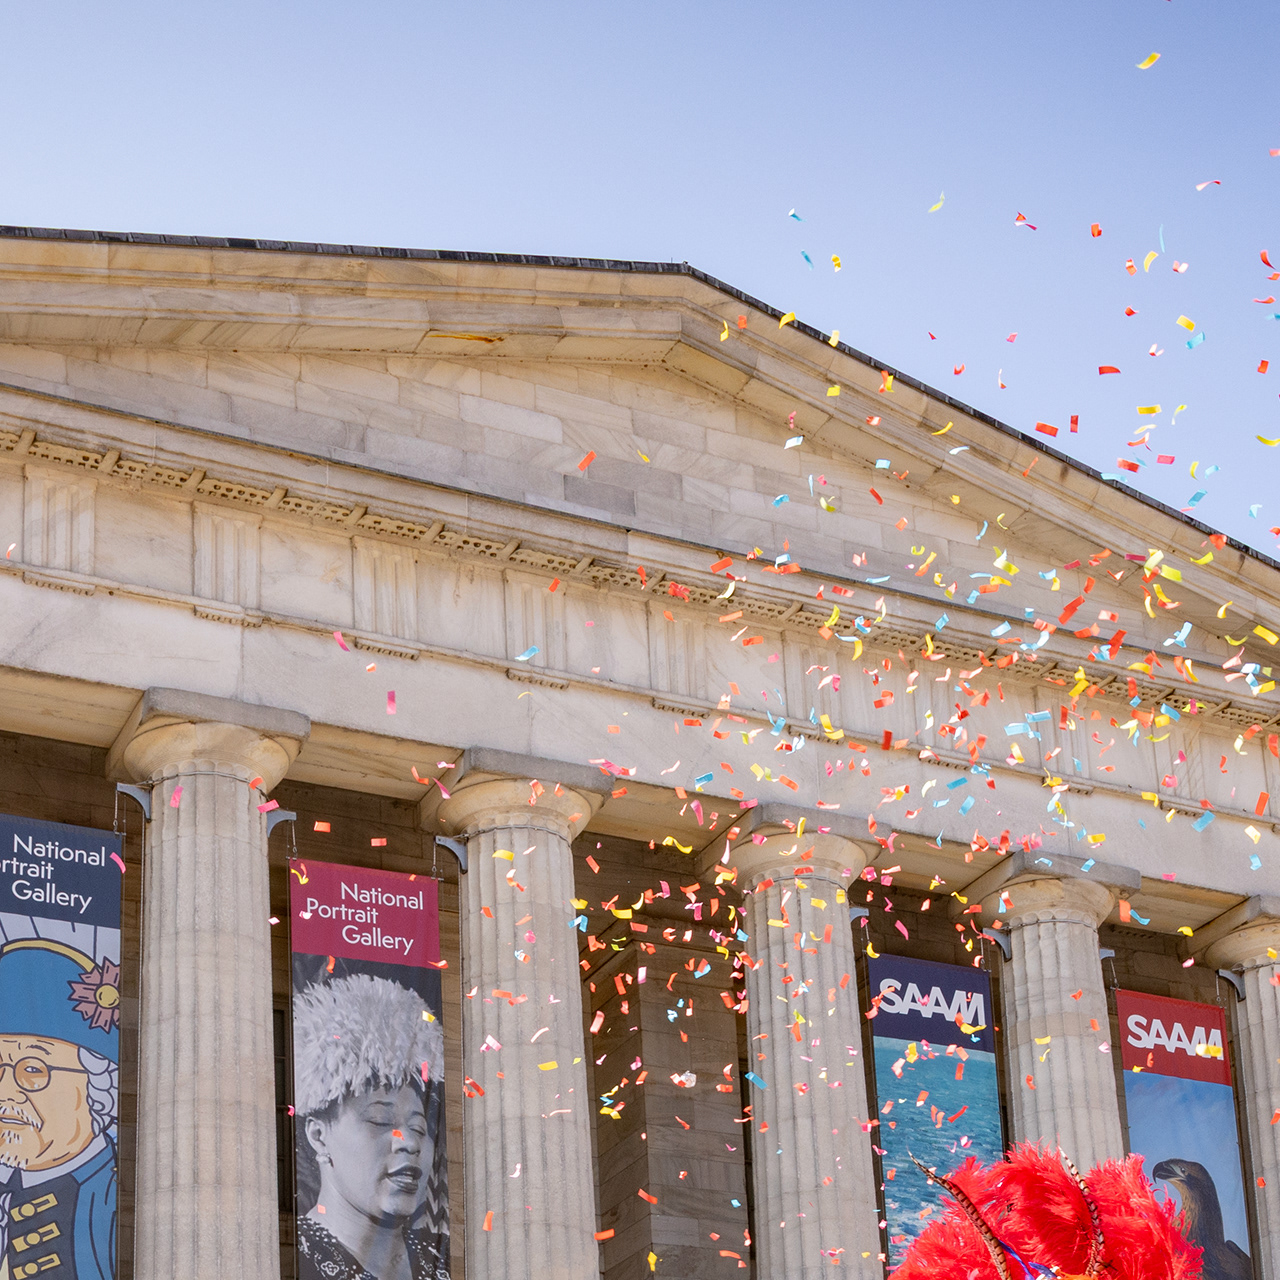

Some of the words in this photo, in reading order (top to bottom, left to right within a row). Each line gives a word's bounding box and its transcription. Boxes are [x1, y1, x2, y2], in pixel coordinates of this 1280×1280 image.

[13, 833, 106, 867] National
[11, 879, 93, 914] Gallery
[306, 897, 379, 924] Portrait
[340, 881, 424, 911] National
[341, 924, 414, 956] Gallery
[879, 978, 986, 1027] SAAM
[1126, 1014, 1225, 1061] SAAM
